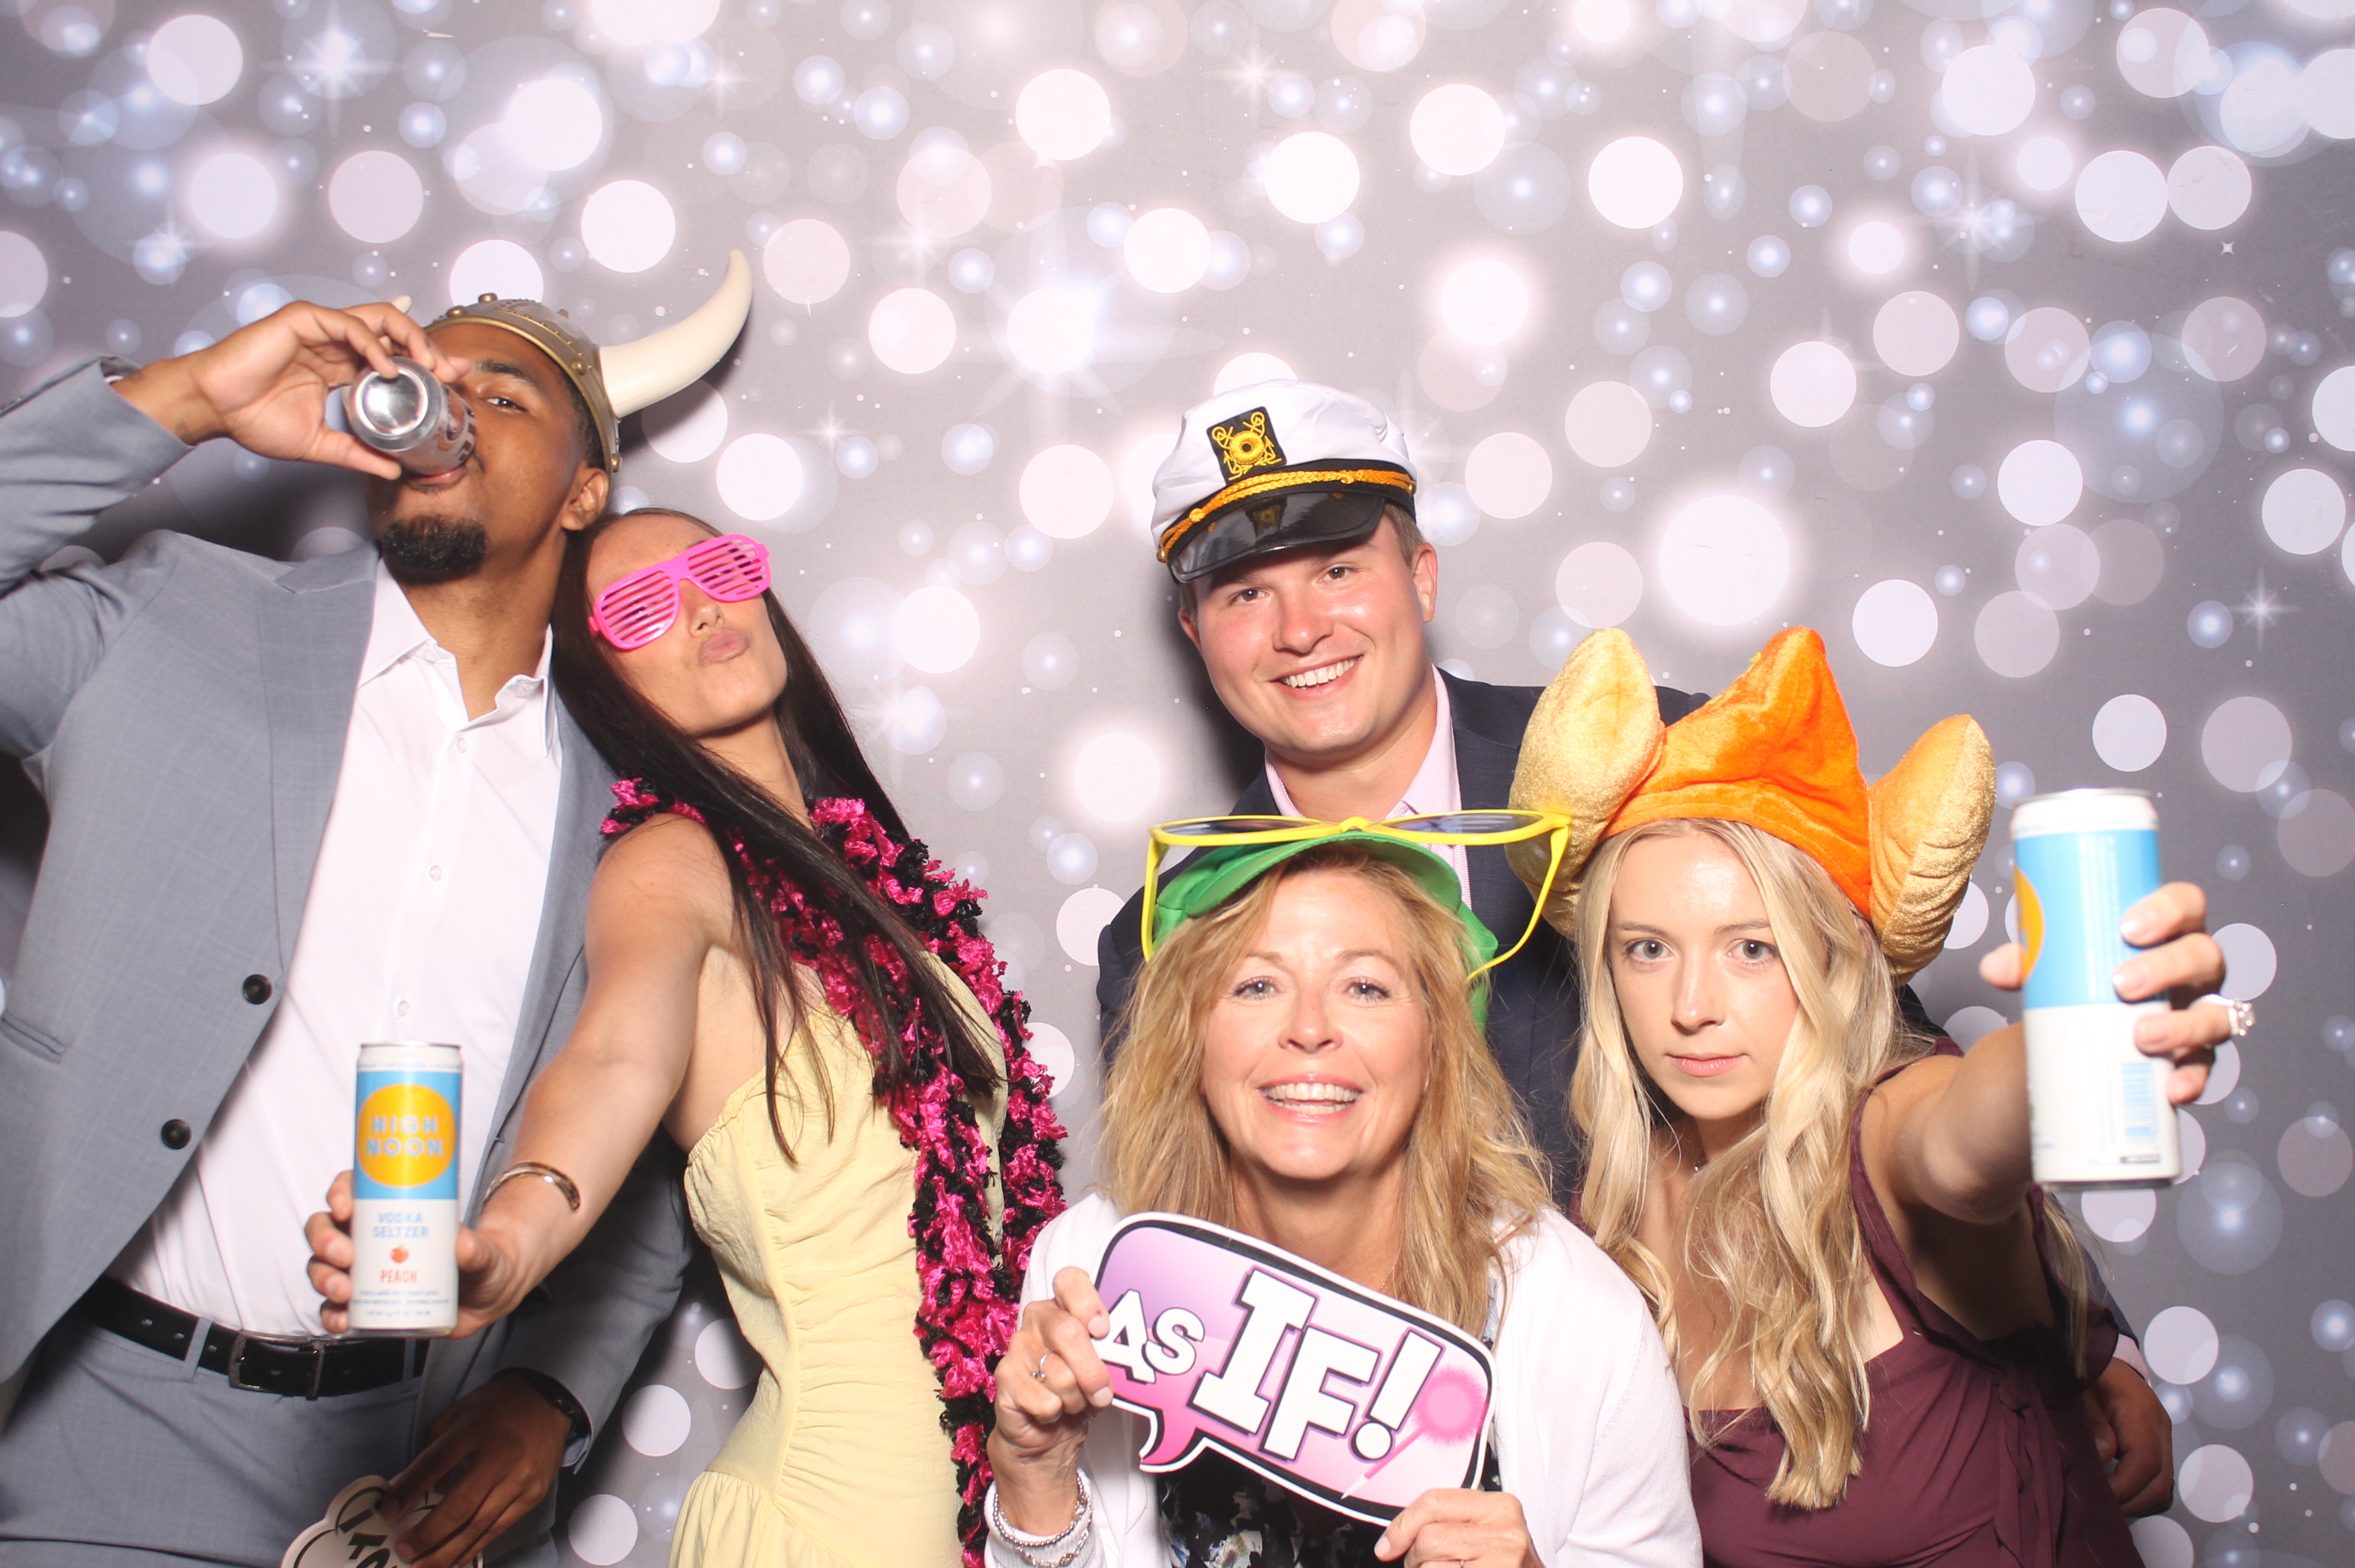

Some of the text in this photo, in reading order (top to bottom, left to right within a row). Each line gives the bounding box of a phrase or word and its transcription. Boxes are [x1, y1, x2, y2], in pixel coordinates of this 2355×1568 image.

[371, 1115, 439, 1135] HIGH
[366, 1137, 444, 1157] NOON
[377, 1212, 423, 1224] VODKA
[371, 1226, 429, 1239] SELTZER
[380, 1269, 418, 1282] PEACH
[1091, 1268, 1444, 1462] AS IF!
